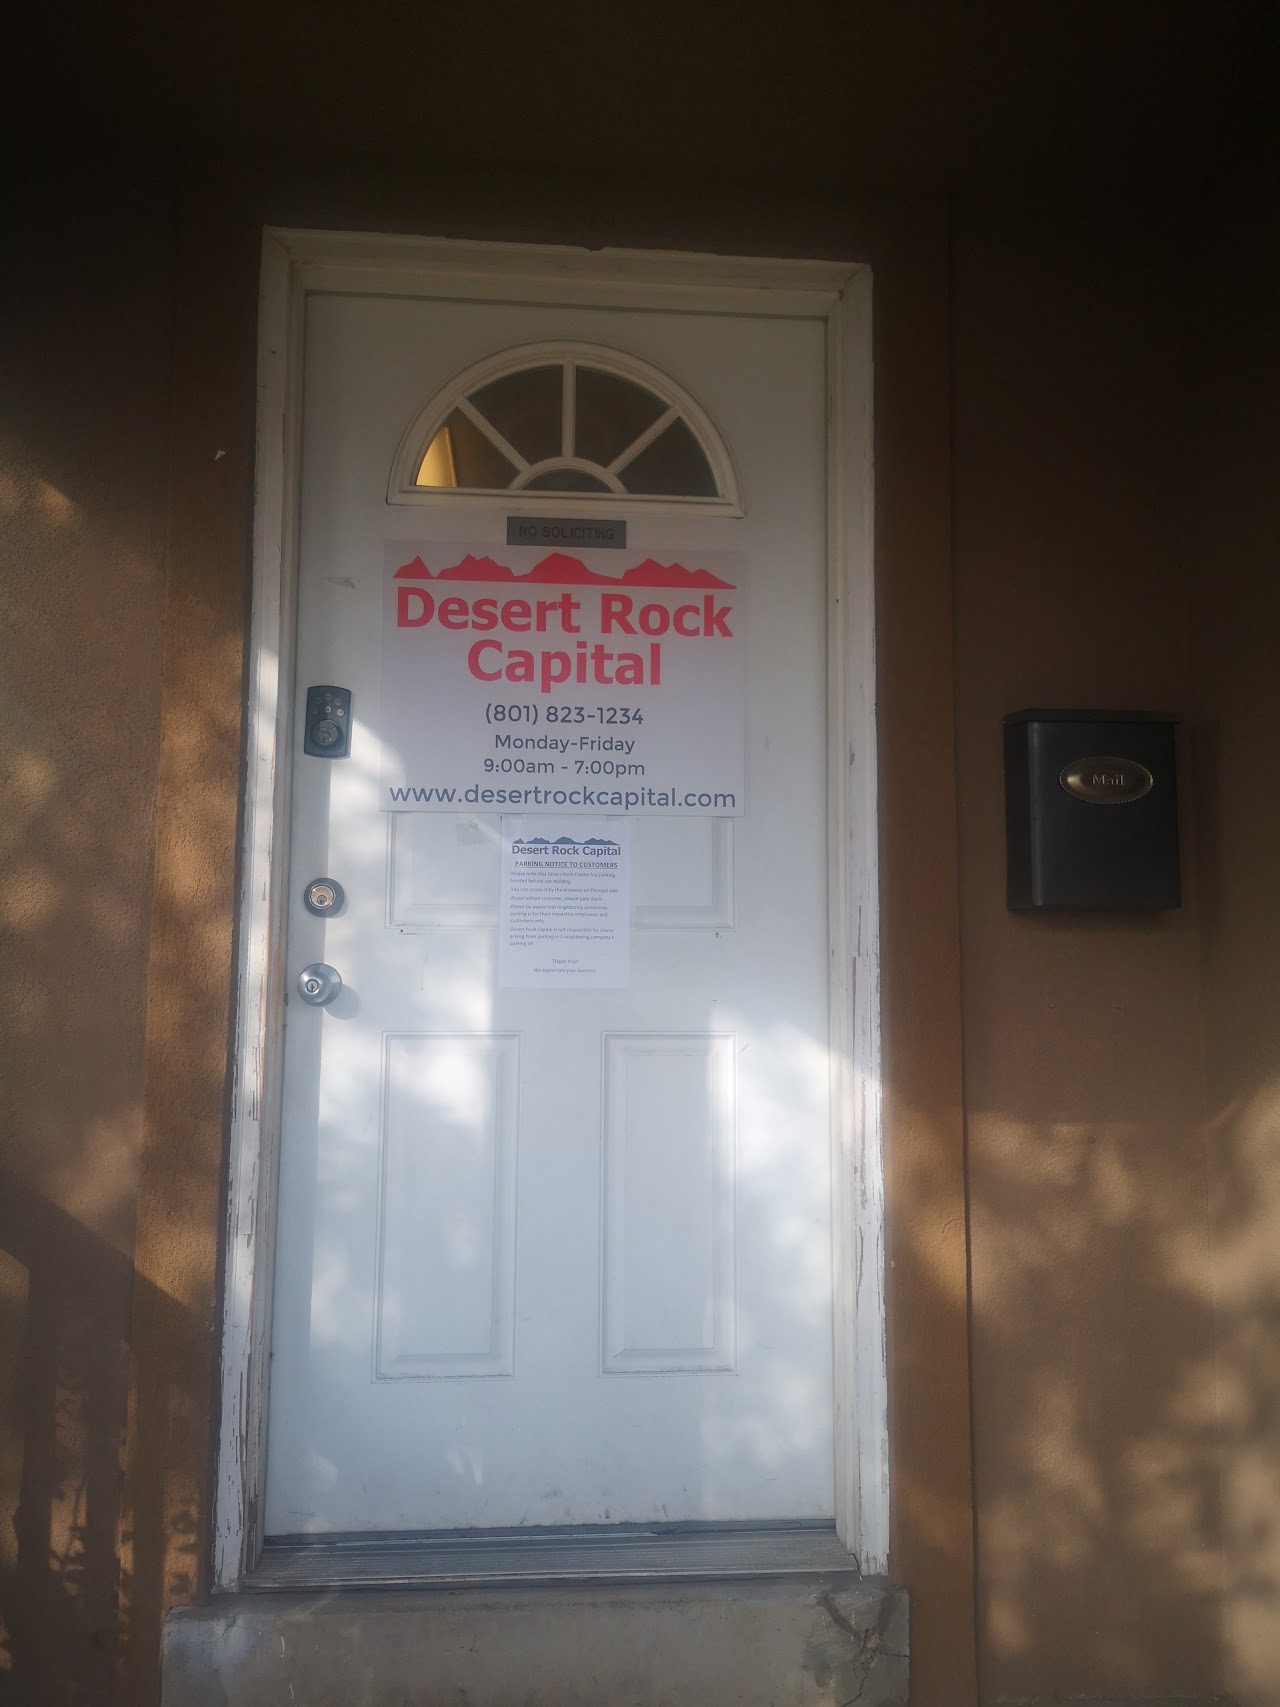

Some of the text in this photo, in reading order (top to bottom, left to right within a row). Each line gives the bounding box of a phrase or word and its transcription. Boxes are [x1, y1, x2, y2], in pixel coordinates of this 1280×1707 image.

[519, 525, 614, 541] NO SOLICITING
[397, 586, 734, 638] Desert Rock
[467, 639, 661, 693] Capital
[485, 703, 644, 726] (801) 823-1234
[495, 734, 635, 754] Monday-Friday
[483, 758, 555, 775] 9:00am
[574, 760, 645, 777] 7:00pm
[1092, 774, 1124, 786] Mail
[389, 784, 736, 810] www.desertrockcapital.com
[512, 845, 621, 858] Desert Rock Capital
